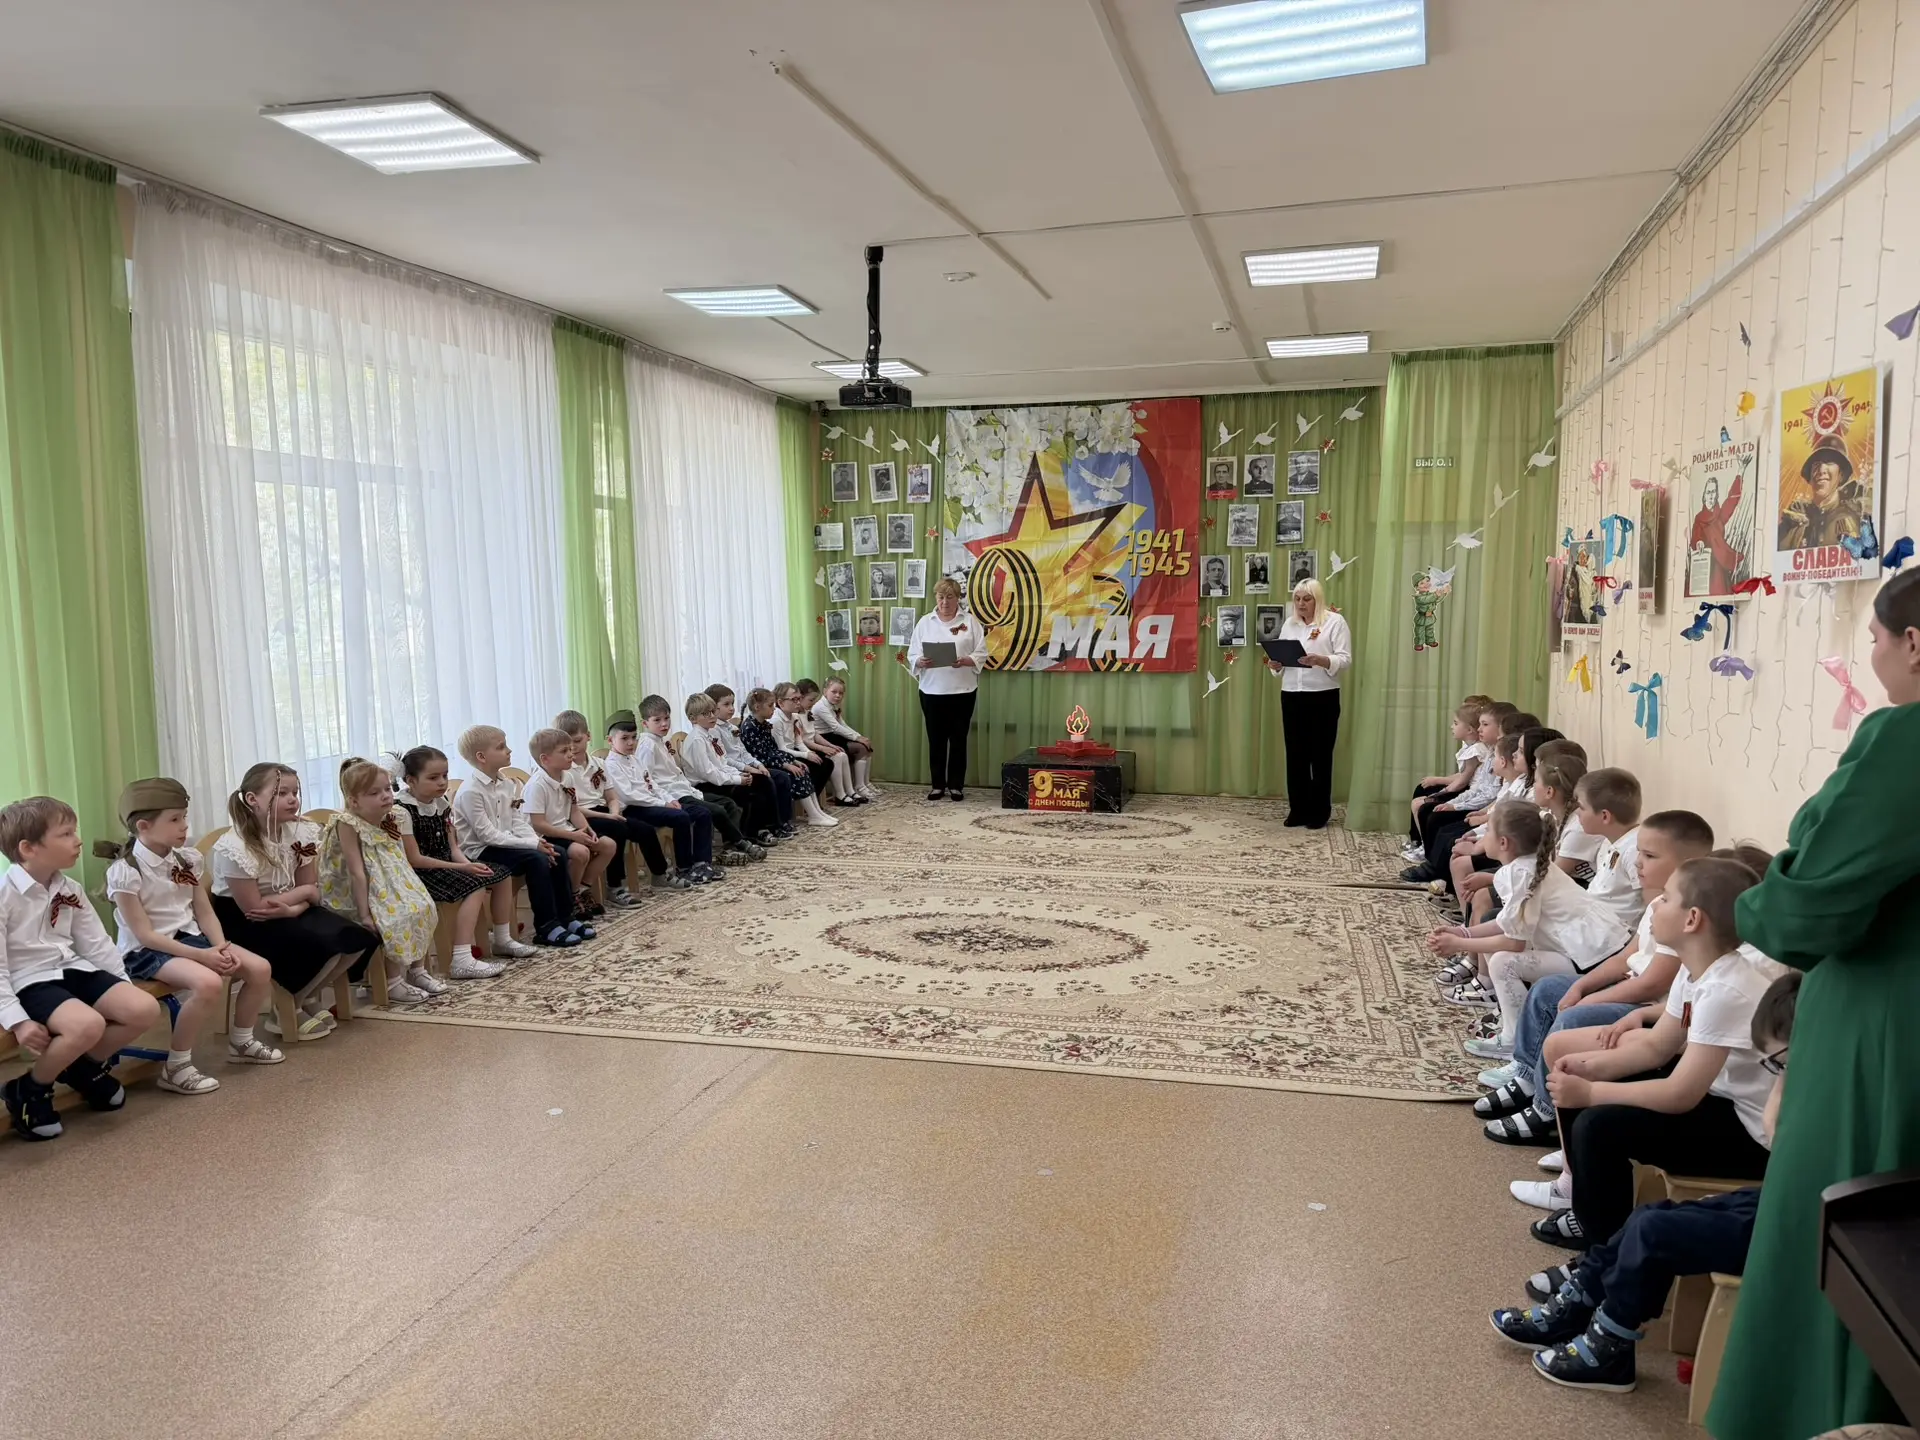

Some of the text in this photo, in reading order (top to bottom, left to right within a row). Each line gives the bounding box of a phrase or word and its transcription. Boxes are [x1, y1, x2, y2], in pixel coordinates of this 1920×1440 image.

[1784, 419, 1803, 433] 1941
[1692, 441, 1755, 465] РОДИНА-МАТЬ
[1126, 528, 1185, 553] 1941
[1128, 551, 1192, 577] 1945
[1792, 546, 1851, 570] СЛАВА
[1047, 614, 1175, 659] МАЯ
[1033, 771, 1080, 799] 9 МАЯ
